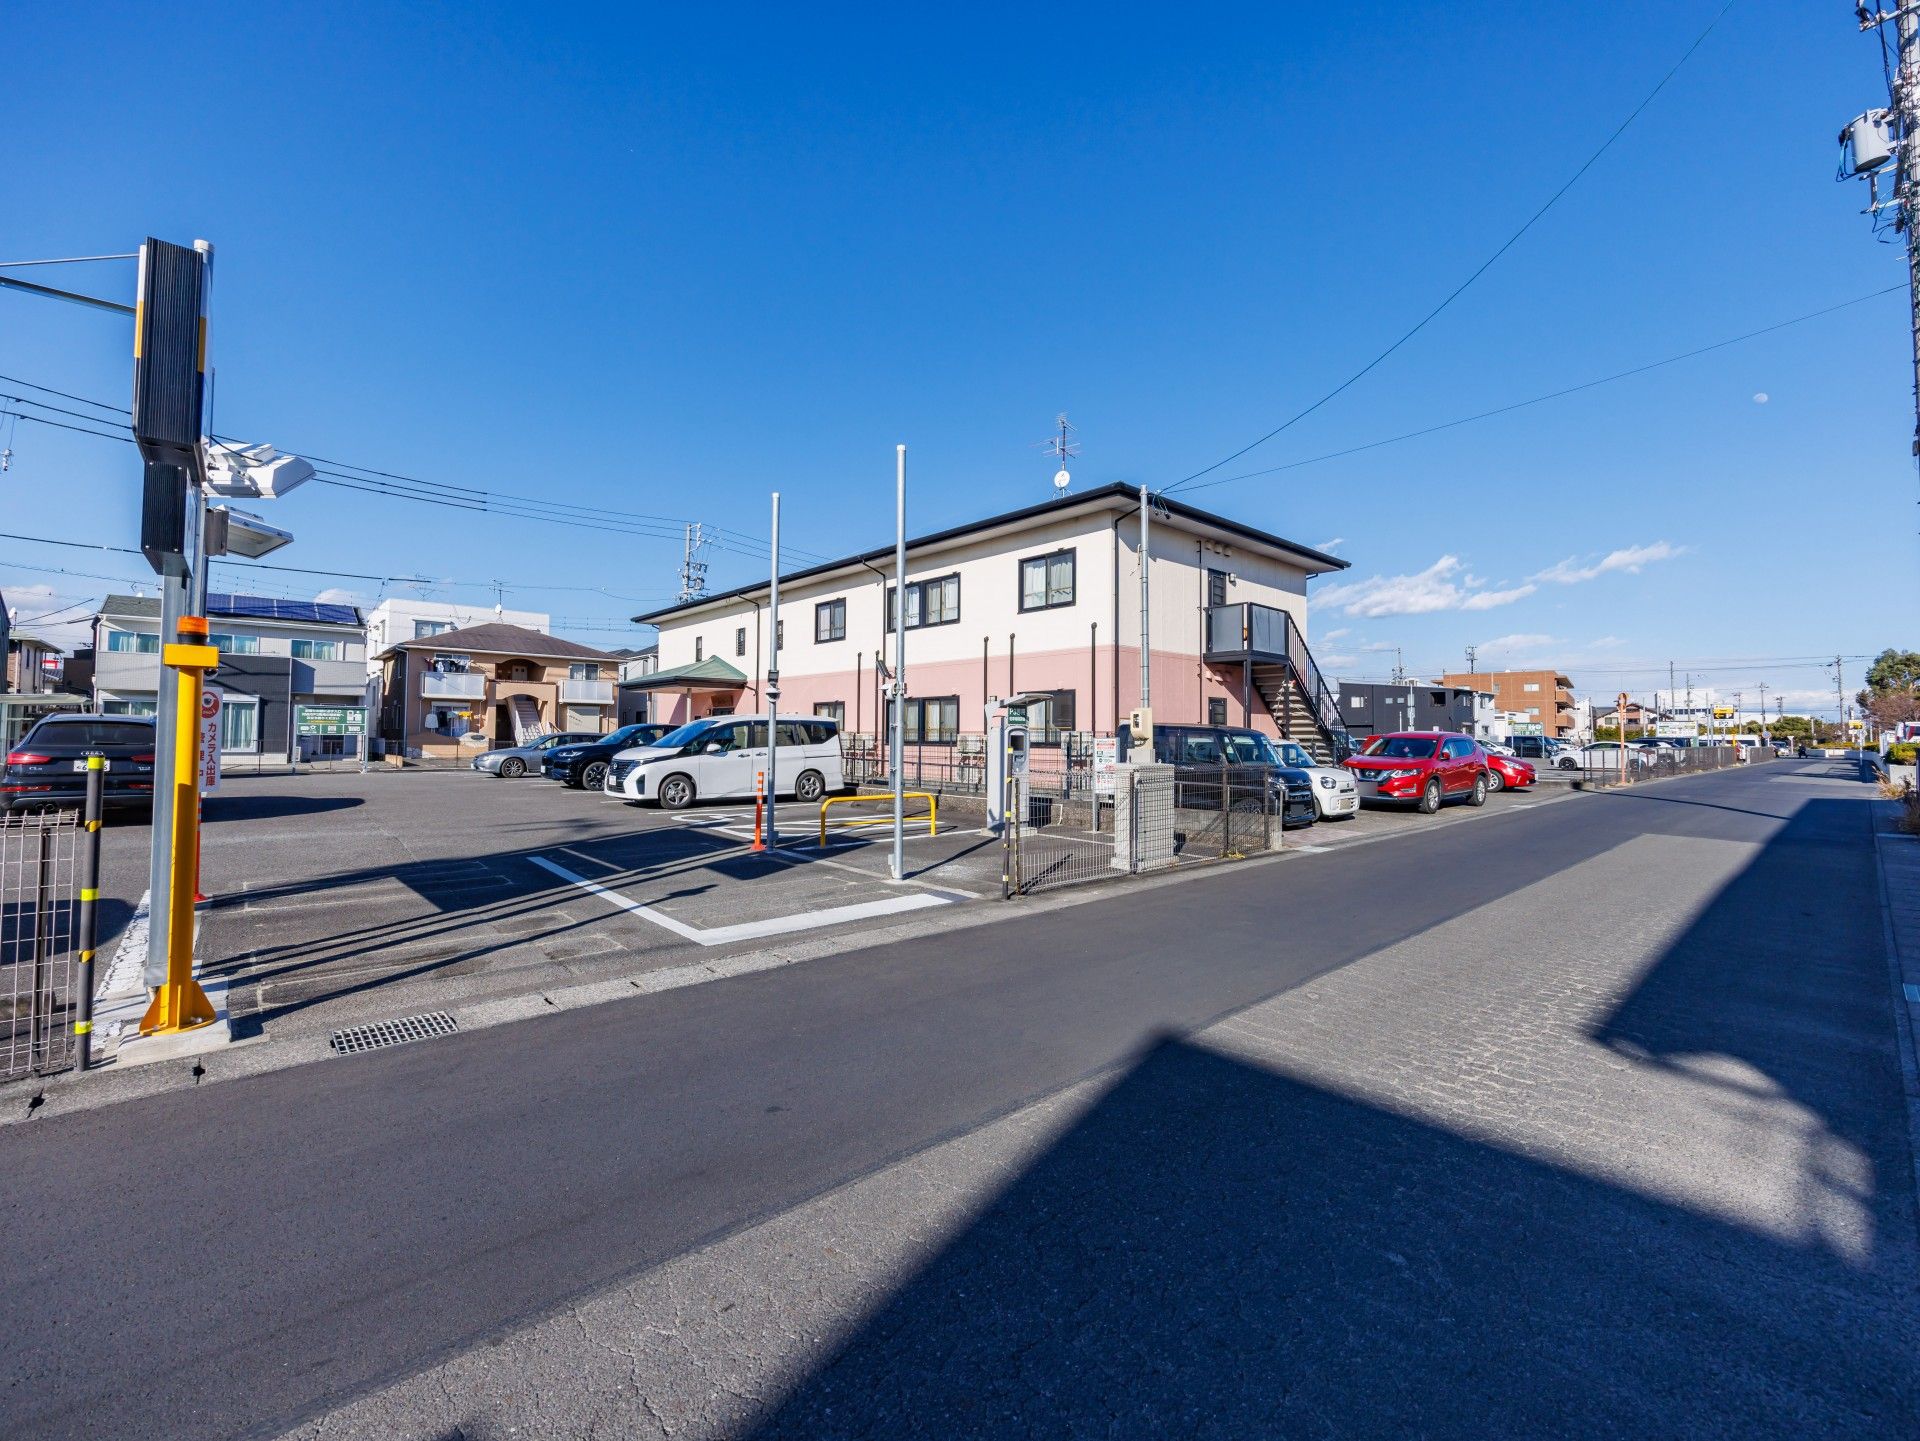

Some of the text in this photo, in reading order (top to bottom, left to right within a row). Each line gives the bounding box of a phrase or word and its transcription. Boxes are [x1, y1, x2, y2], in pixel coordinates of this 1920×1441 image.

[205, 722, 217, 787] カメラ入出庫
